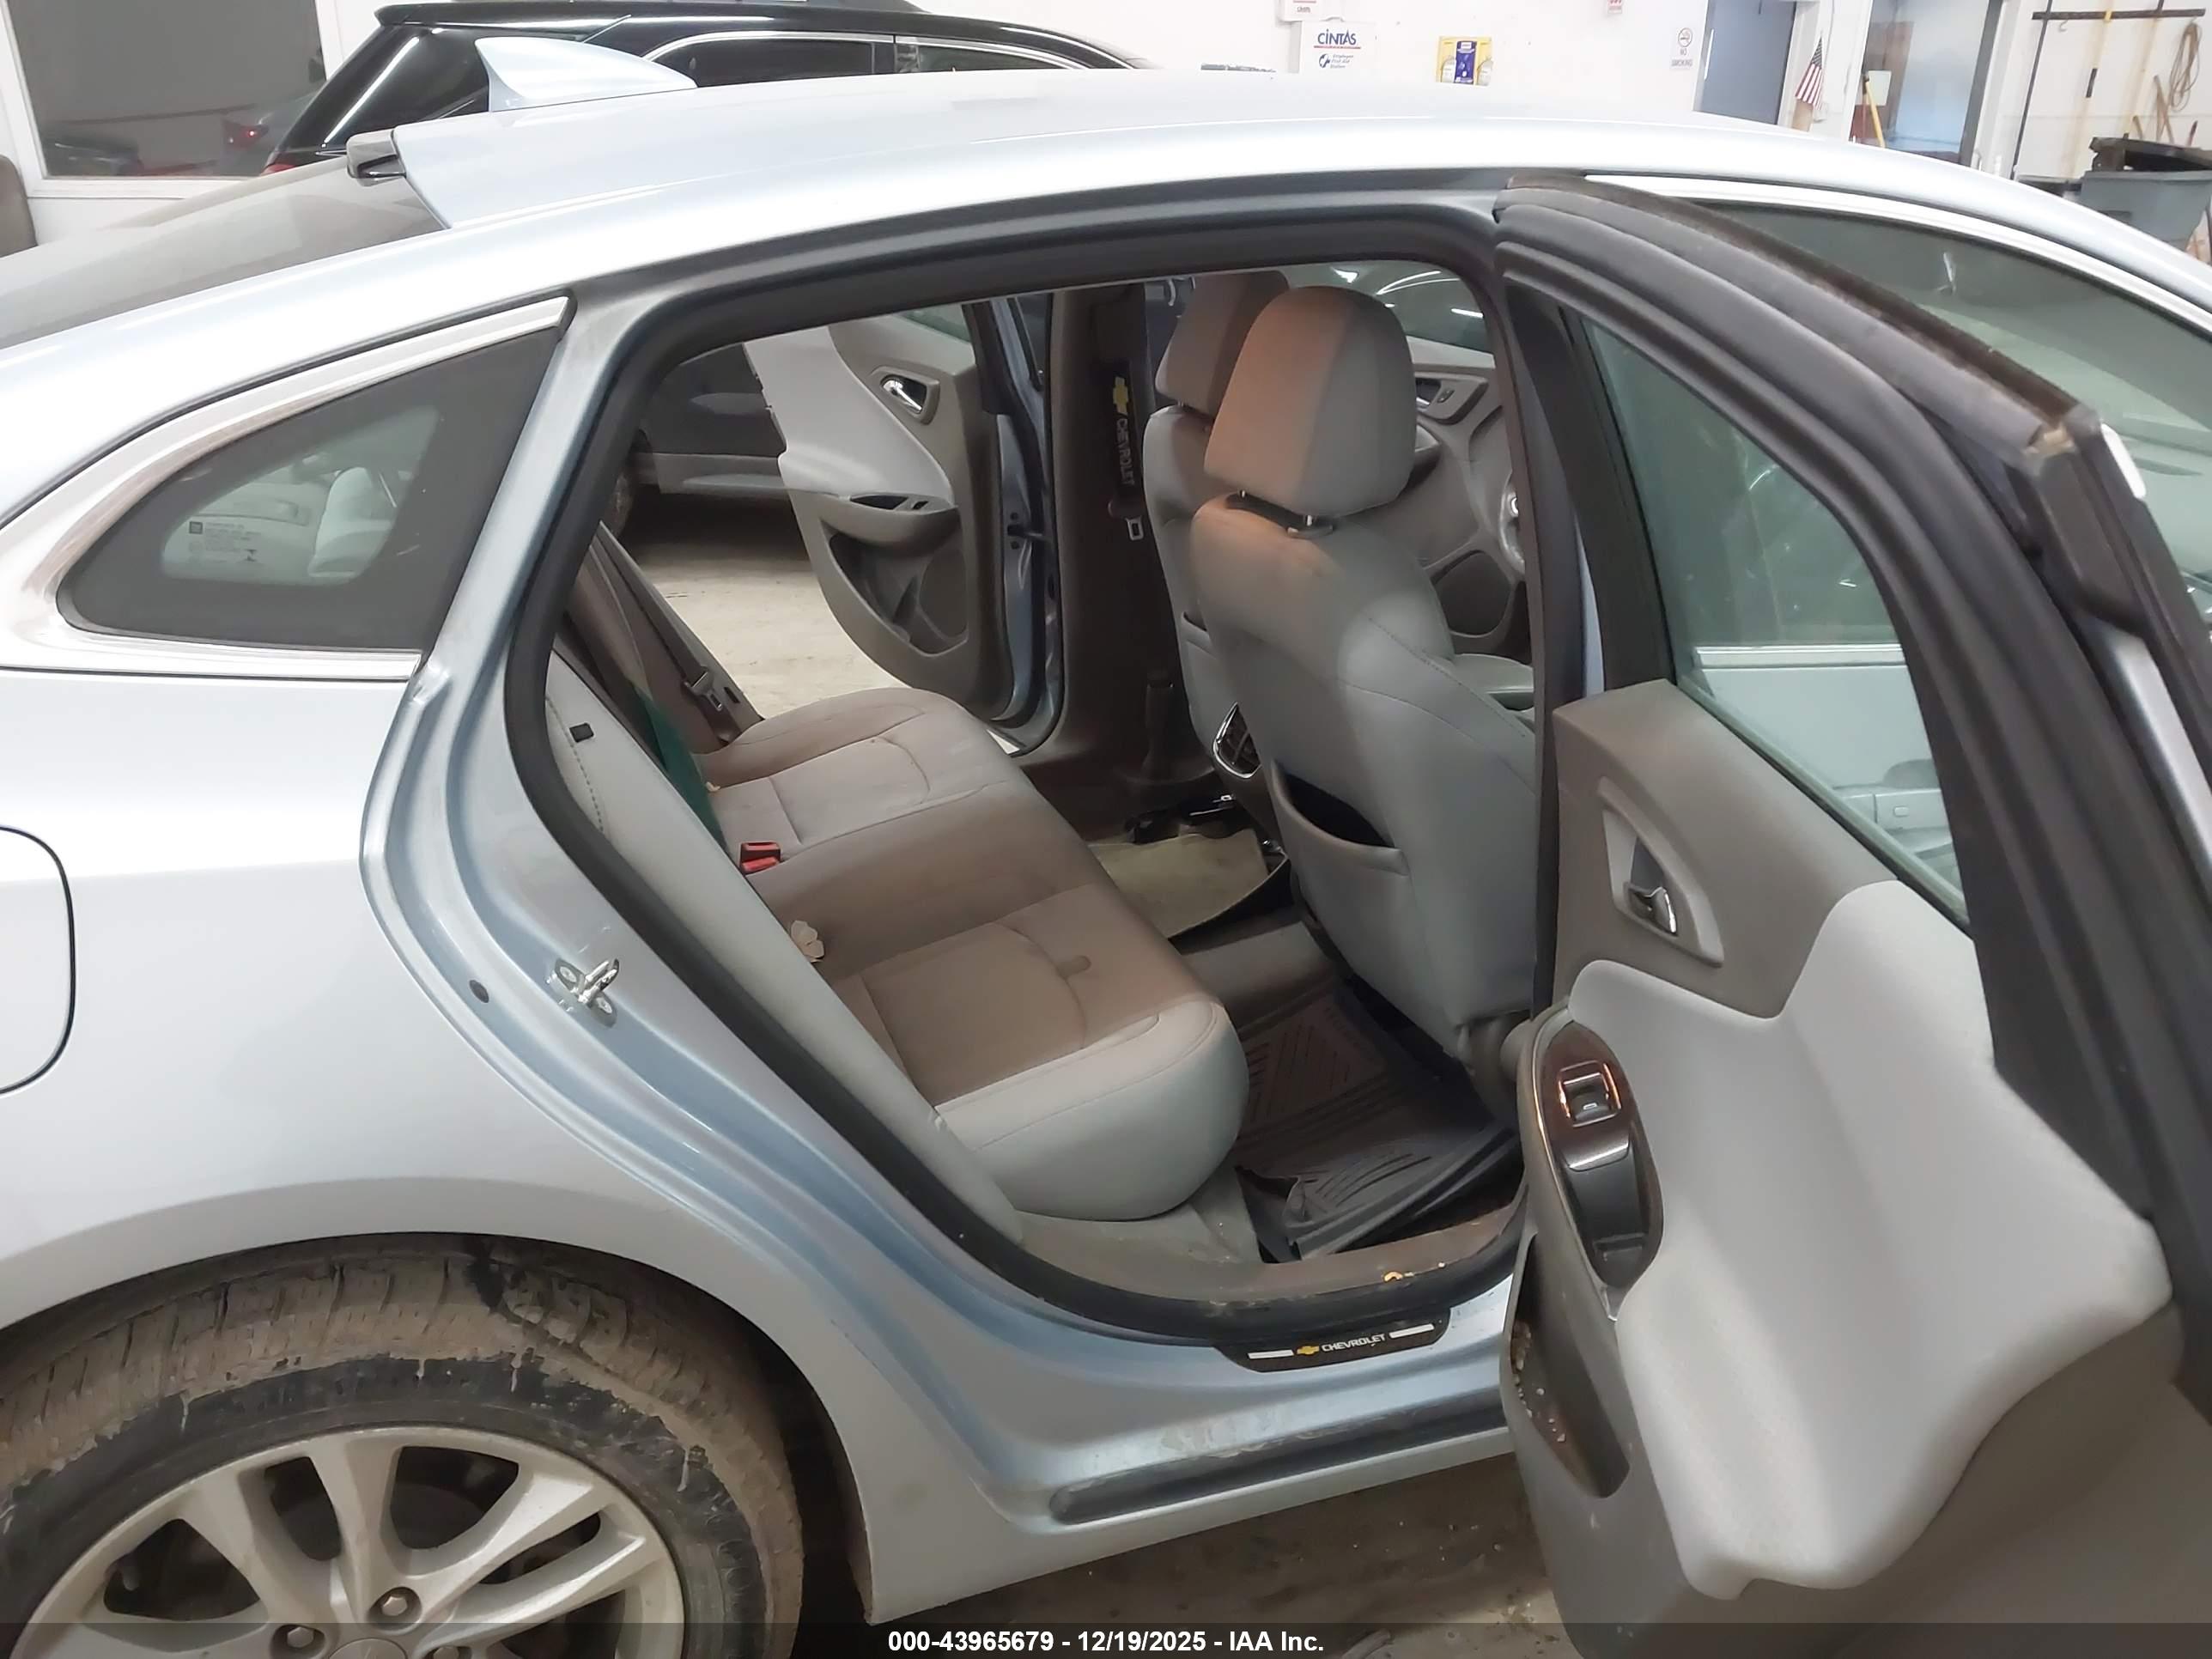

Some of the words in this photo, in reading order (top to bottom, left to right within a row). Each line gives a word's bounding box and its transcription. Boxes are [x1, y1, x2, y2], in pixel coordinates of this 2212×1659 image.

[1317, 28, 1357, 46] CINTAS
[1116, 418, 1135, 486] CHEVROLET
[1322, 1333, 1387, 1353] CHEVROLET
